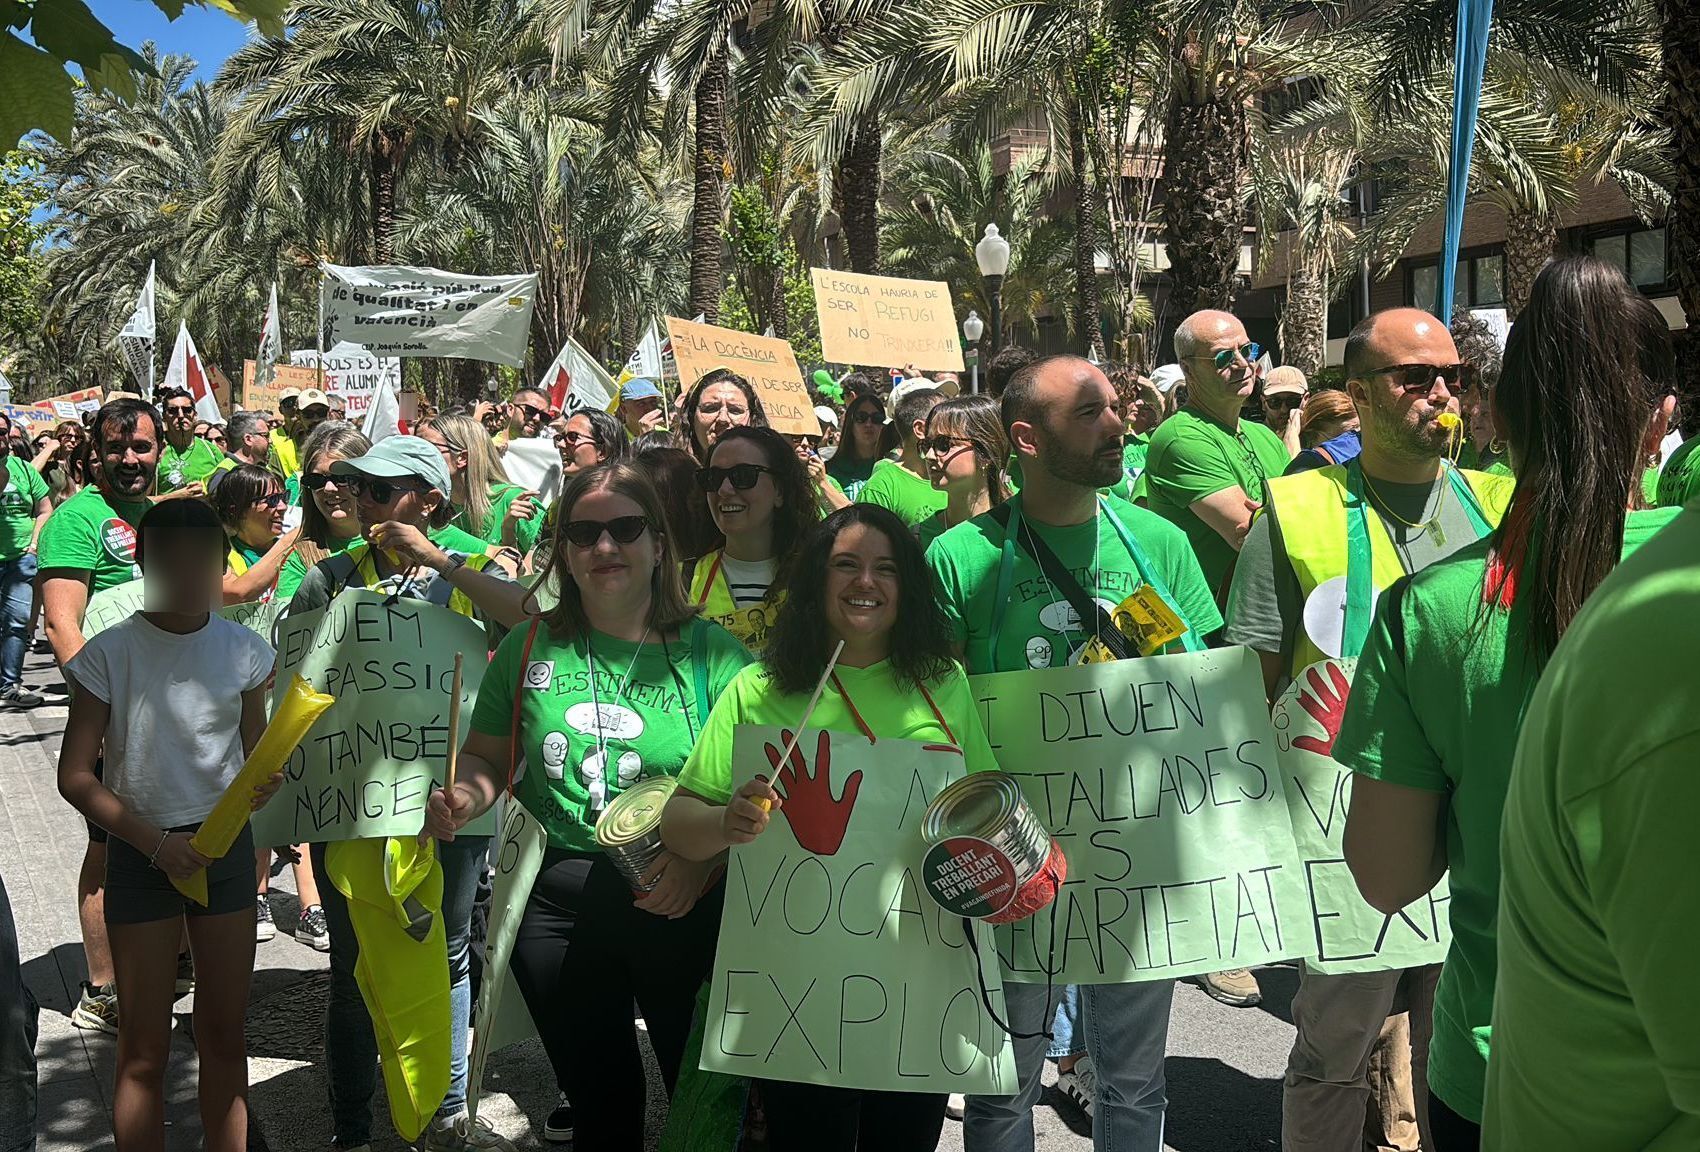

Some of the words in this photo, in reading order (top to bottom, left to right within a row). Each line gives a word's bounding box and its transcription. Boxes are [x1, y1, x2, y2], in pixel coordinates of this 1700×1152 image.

[332, 286, 348, 300] de
[821, 277, 870, 296] L'ESCOLA
[881, 288, 918, 299] HAURIA
[925, 290, 938, 299] DE
[828, 299, 857, 312] SER
[875, 301, 935, 322] REFUGI
[848, 327, 869, 339] NO
[691, 335, 708, 352] LA
[715, 341, 777, 361] DOCÈNCIA
[762, 377, 779, 390] DE
[781, 380, 804, 392] SER
[284, 602, 423, 669] EDUQUEM
[1040, 676, 1204, 742] DIUEN
[931, 853, 999, 891] TREBALLANT
[936, 848, 978, 876] DOCENT
[942, 886, 960, 901] EN
[958, 865, 1004, 893] PRECARI
